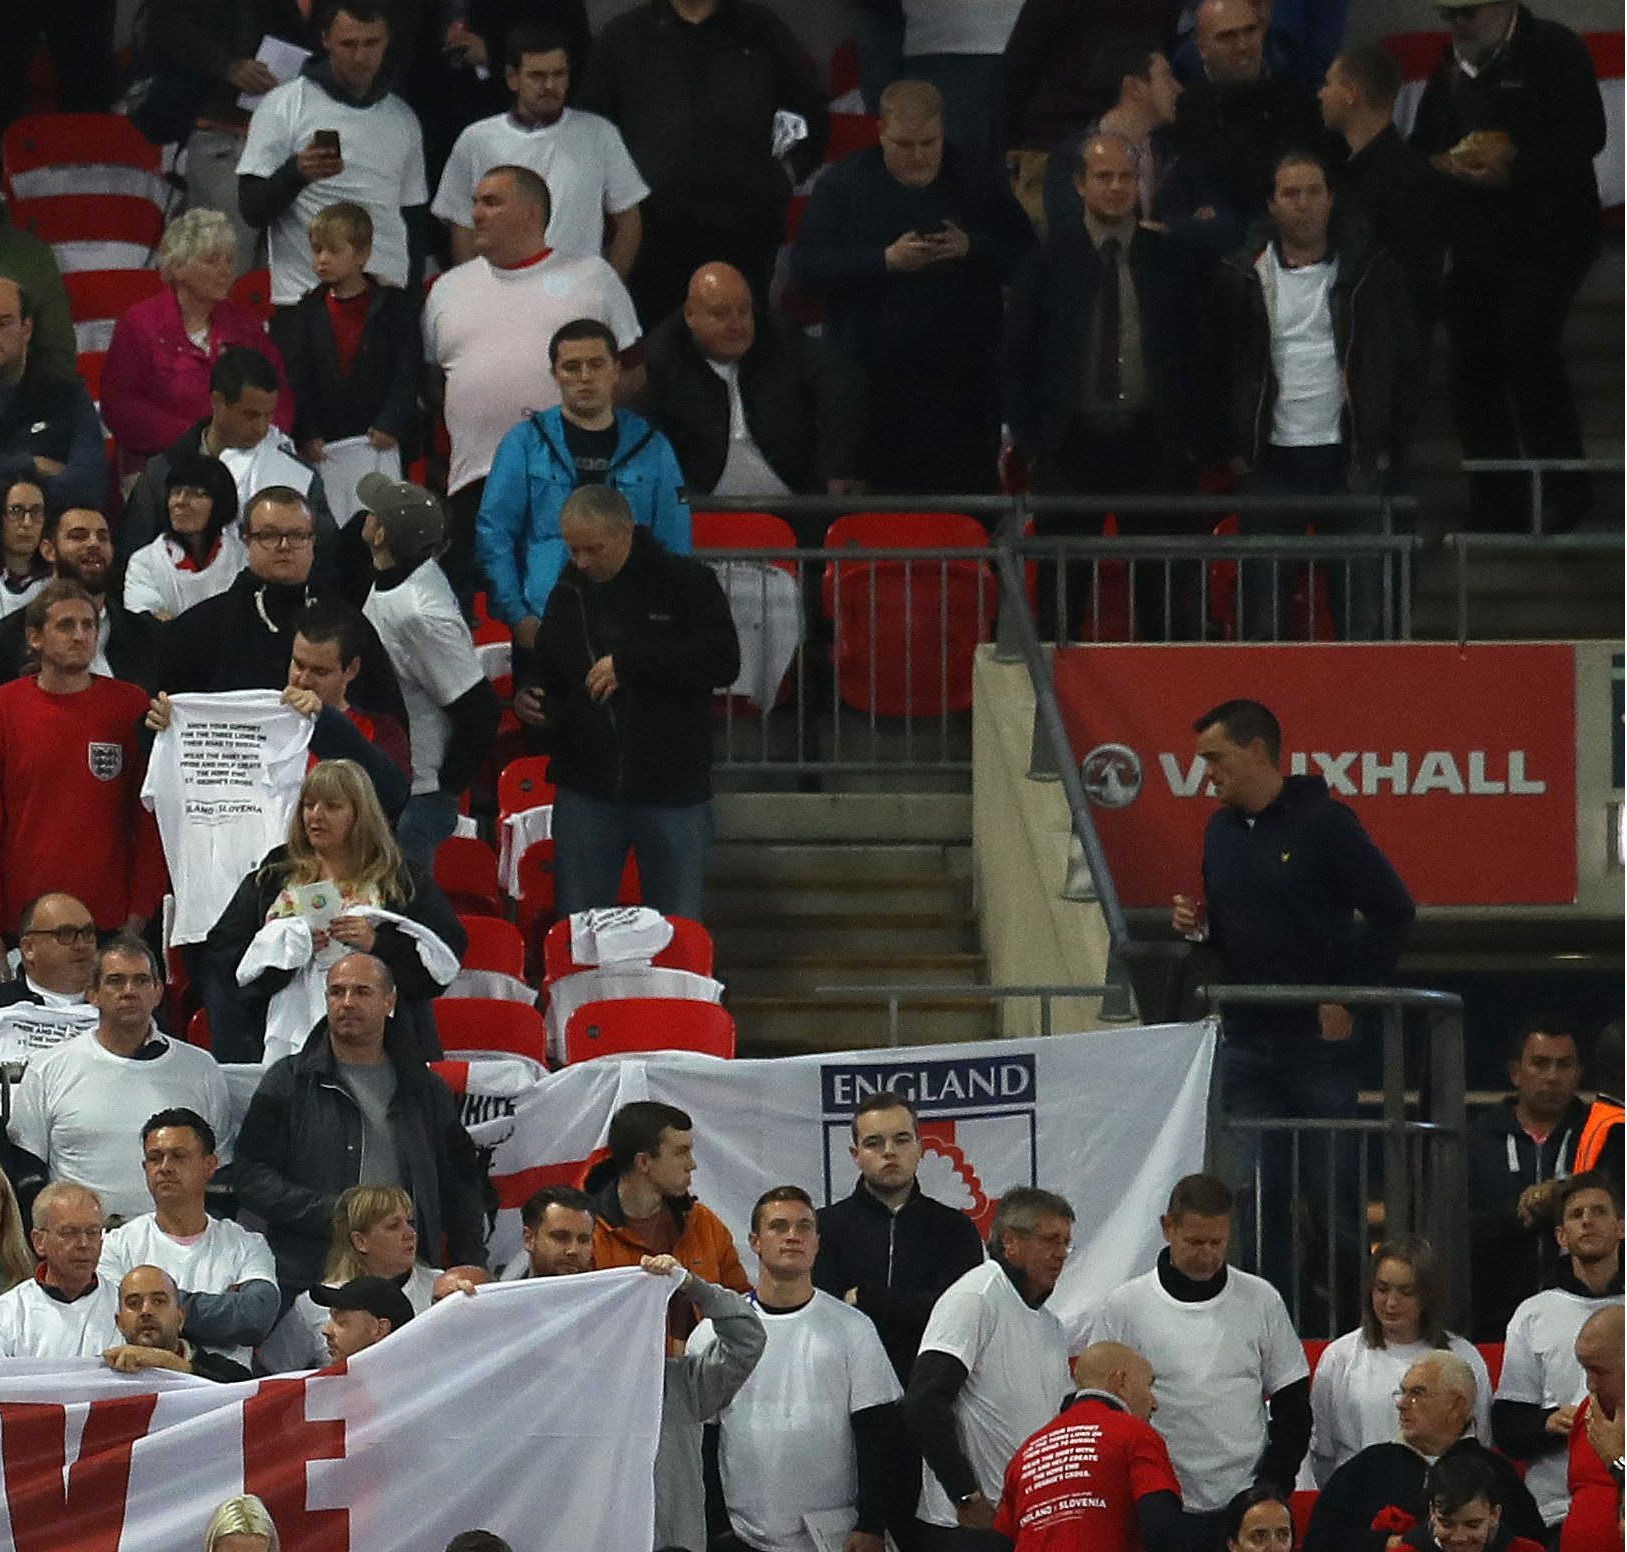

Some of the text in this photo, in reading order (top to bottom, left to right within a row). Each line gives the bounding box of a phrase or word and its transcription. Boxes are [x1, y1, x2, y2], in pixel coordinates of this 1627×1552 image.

[1158, 750, 1546, 796] VXHALL
[834, 1064, 1030, 1105] ENGLAND
[1059, 1498, 1106, 1510] SLOVENIA
